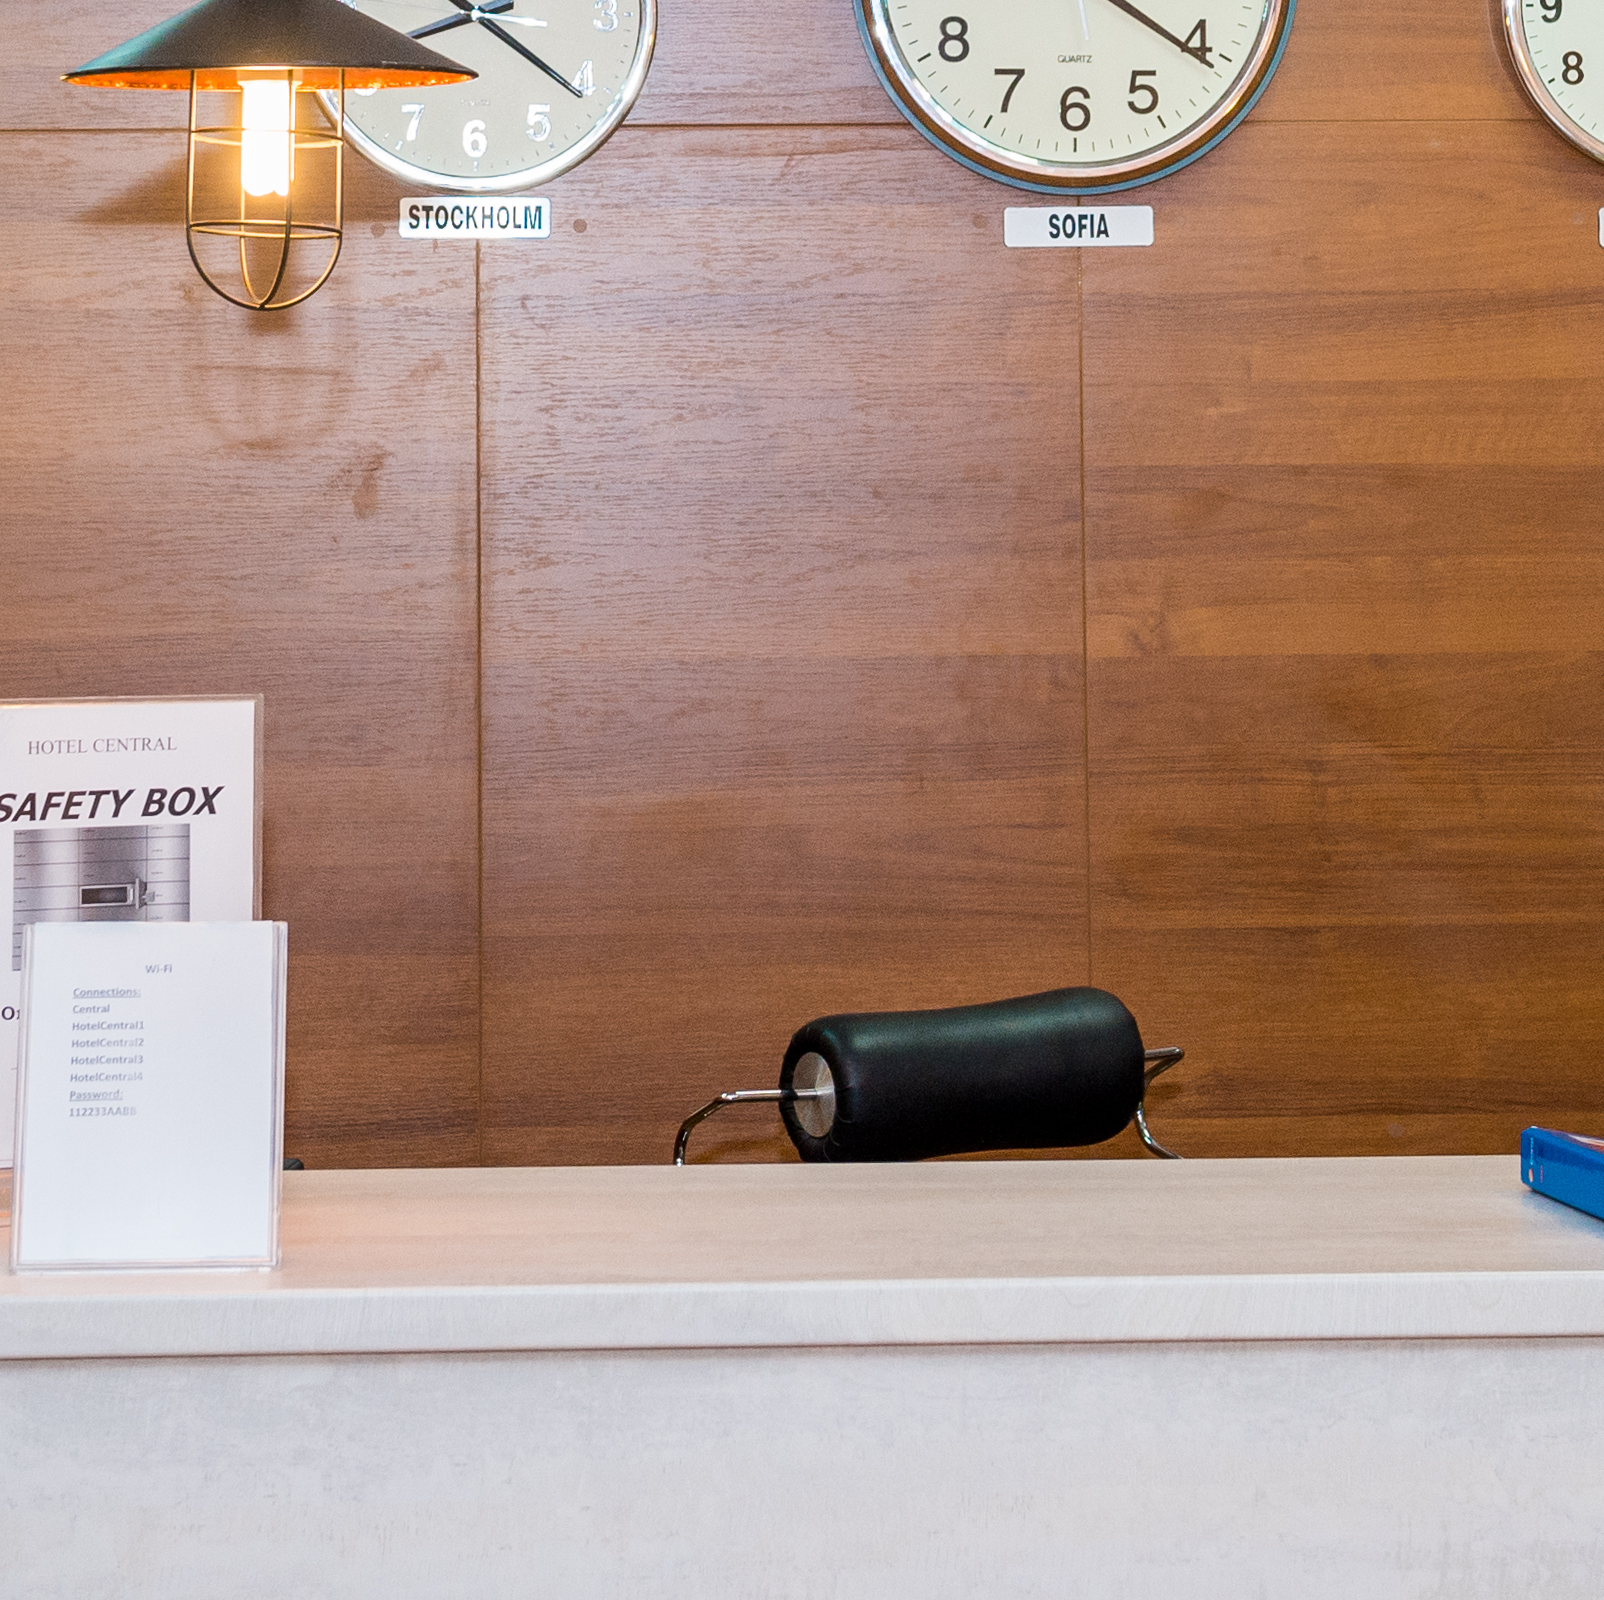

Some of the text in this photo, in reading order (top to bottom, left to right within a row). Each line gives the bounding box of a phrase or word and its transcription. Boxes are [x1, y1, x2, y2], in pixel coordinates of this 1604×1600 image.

[938, 16, 970, 63] 8
[1181, 18, 1213, 66] 4
[1057, 54, 1093, 64] QUARTZ
[1561, 51, 1585, 85] 8
[571, 60, 596, 96] 4
[994, 68, 1026, 114] 7
[1127, 69, 1159, 115] 5
[1059, 86, 1092, 132] 6
[401, 103, 425, 142] 7
[526, 103, 551, 142] 5
[462, 120, 488, 157] 6
[408, 205, 543, 231] STOCKHOLM
[1048, 214, 1110, 240] SOFIA
[28, 736, 178, 755] HOTEL CENTRAL
[140, 785, 225, 817] BOX
[145, 963, 173, 974] Wi-Fi
[73, 987, 141, 997] Connections:
[72, 1004, 110, 1014] Central
[72, 1020, 145, 1032] HotelCentral1
[71, 1037, 145, 1049] HotelCentral2
[70, 1054, 144, 1066] HotelCentral3
[70, 1072, 143, 1083] HotelCentral4
[69, 1089, 123, 1102] Password:
